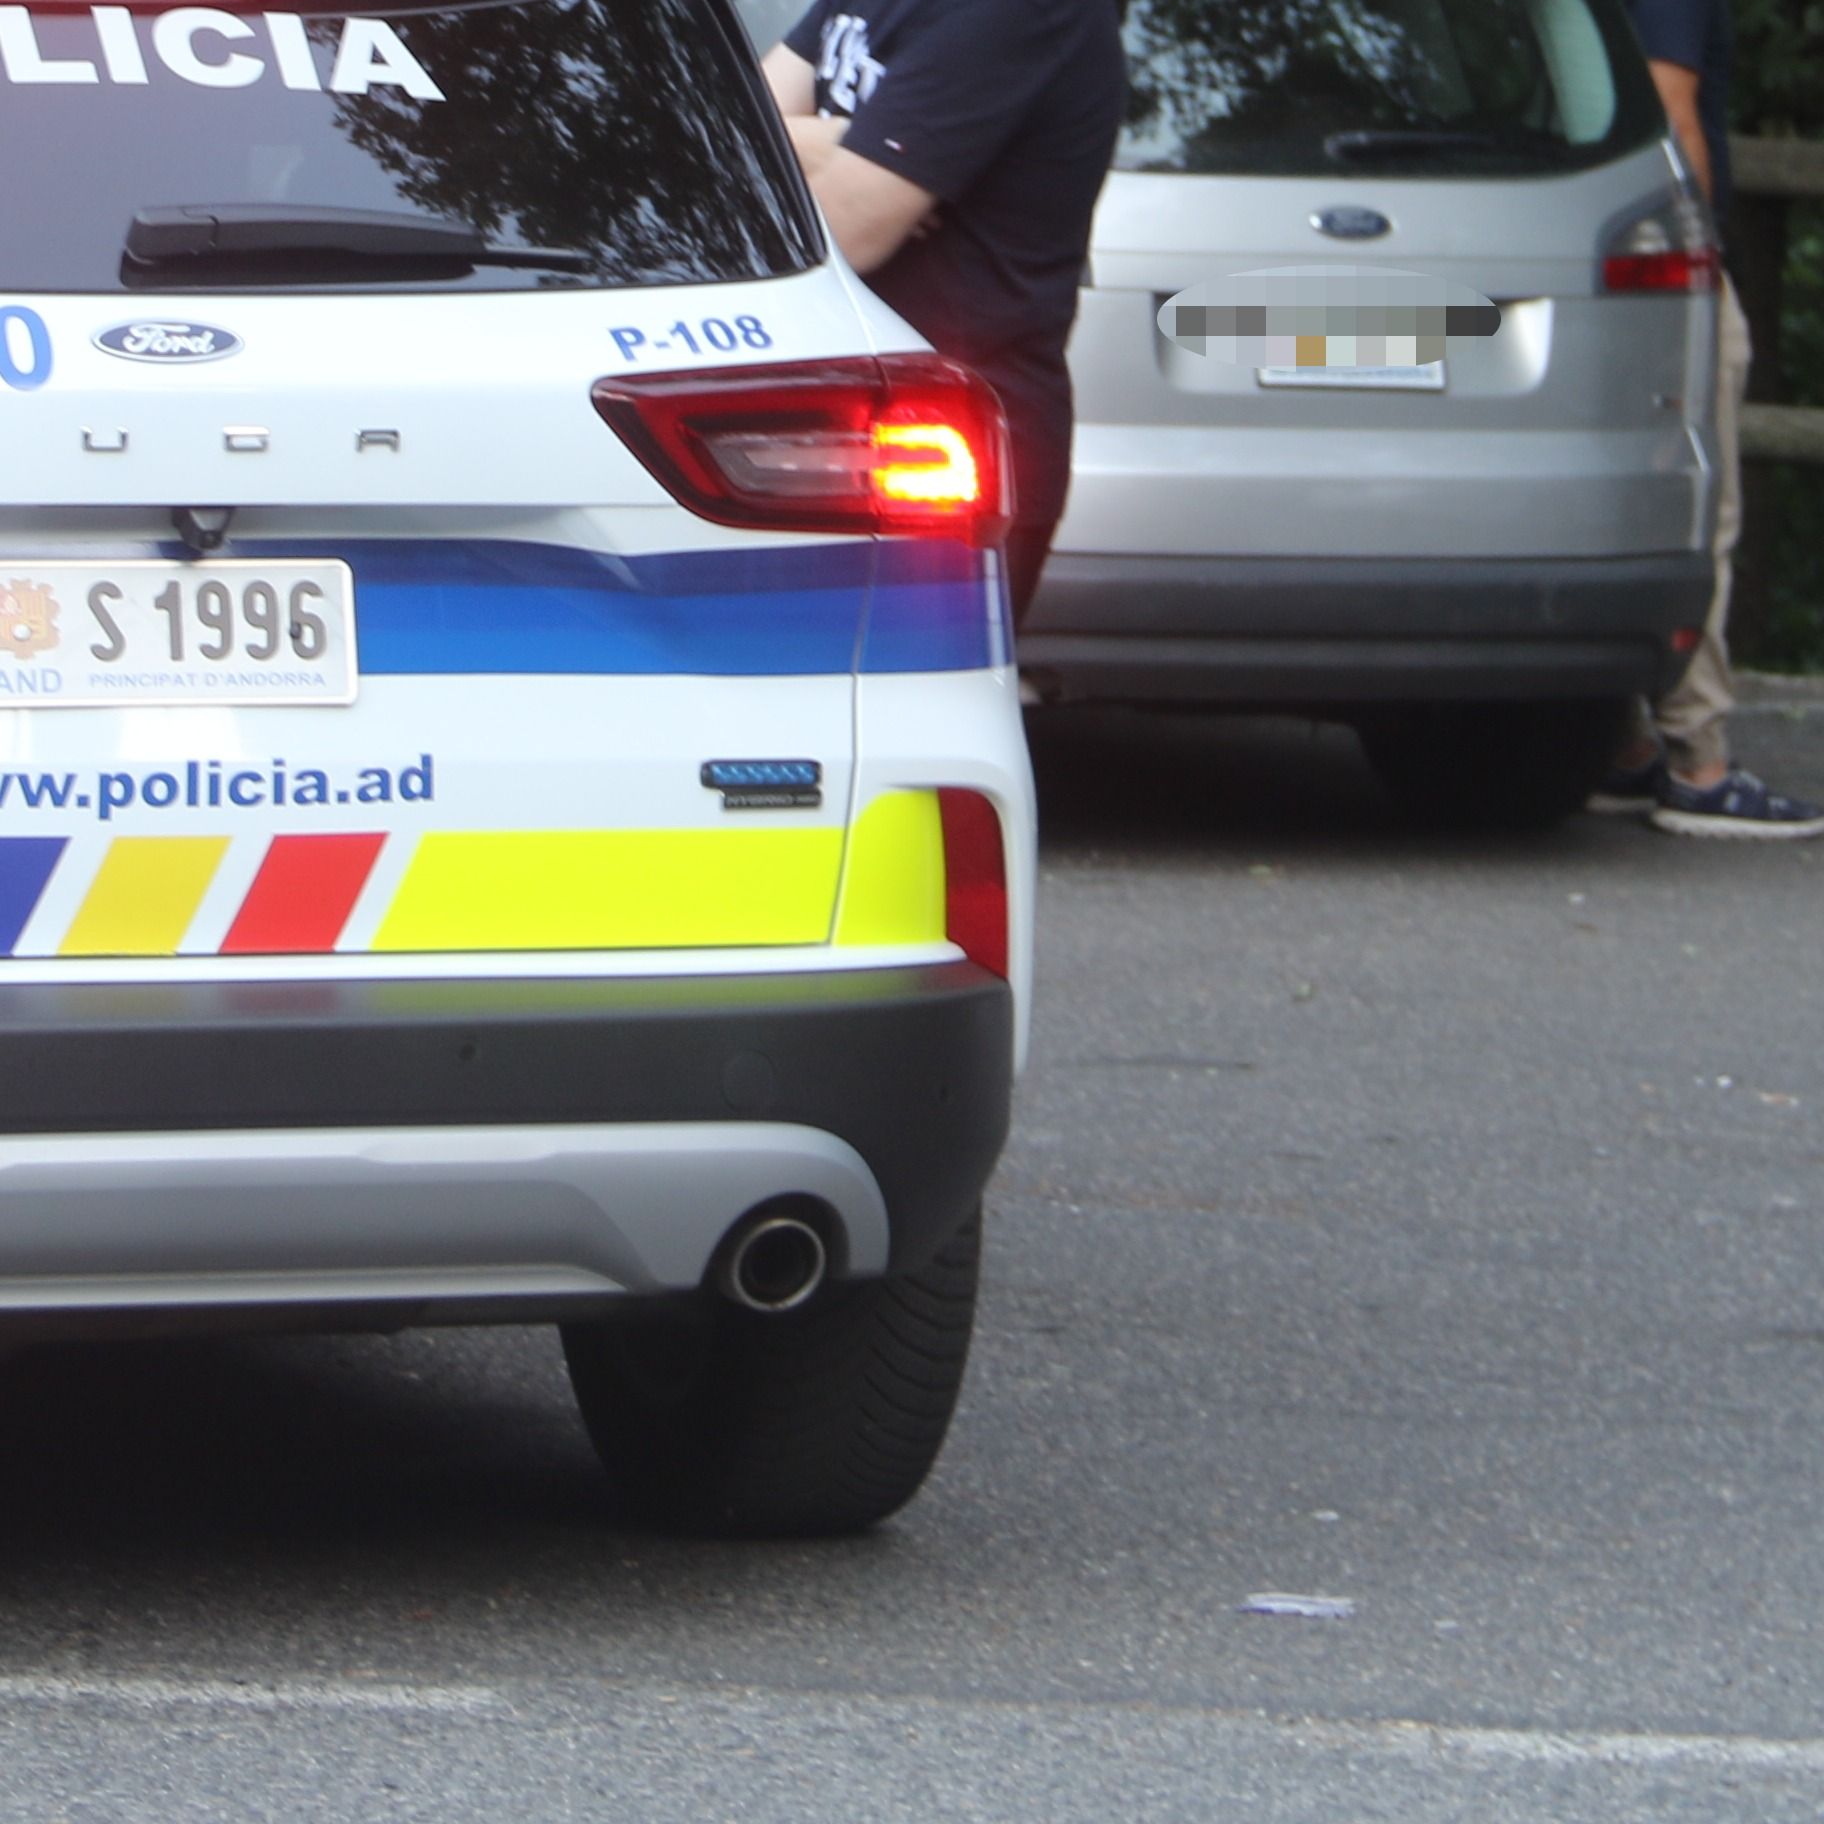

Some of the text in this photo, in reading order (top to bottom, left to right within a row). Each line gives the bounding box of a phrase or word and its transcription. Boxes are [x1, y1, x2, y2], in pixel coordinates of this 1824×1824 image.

[122, 322, 216, 354] Ford
[607, 314, 774, 362] P-108
[87, 579, 328, 662] S 1996
[88, 671, 327, 689] PRINCIPAT D'ANDORRA
